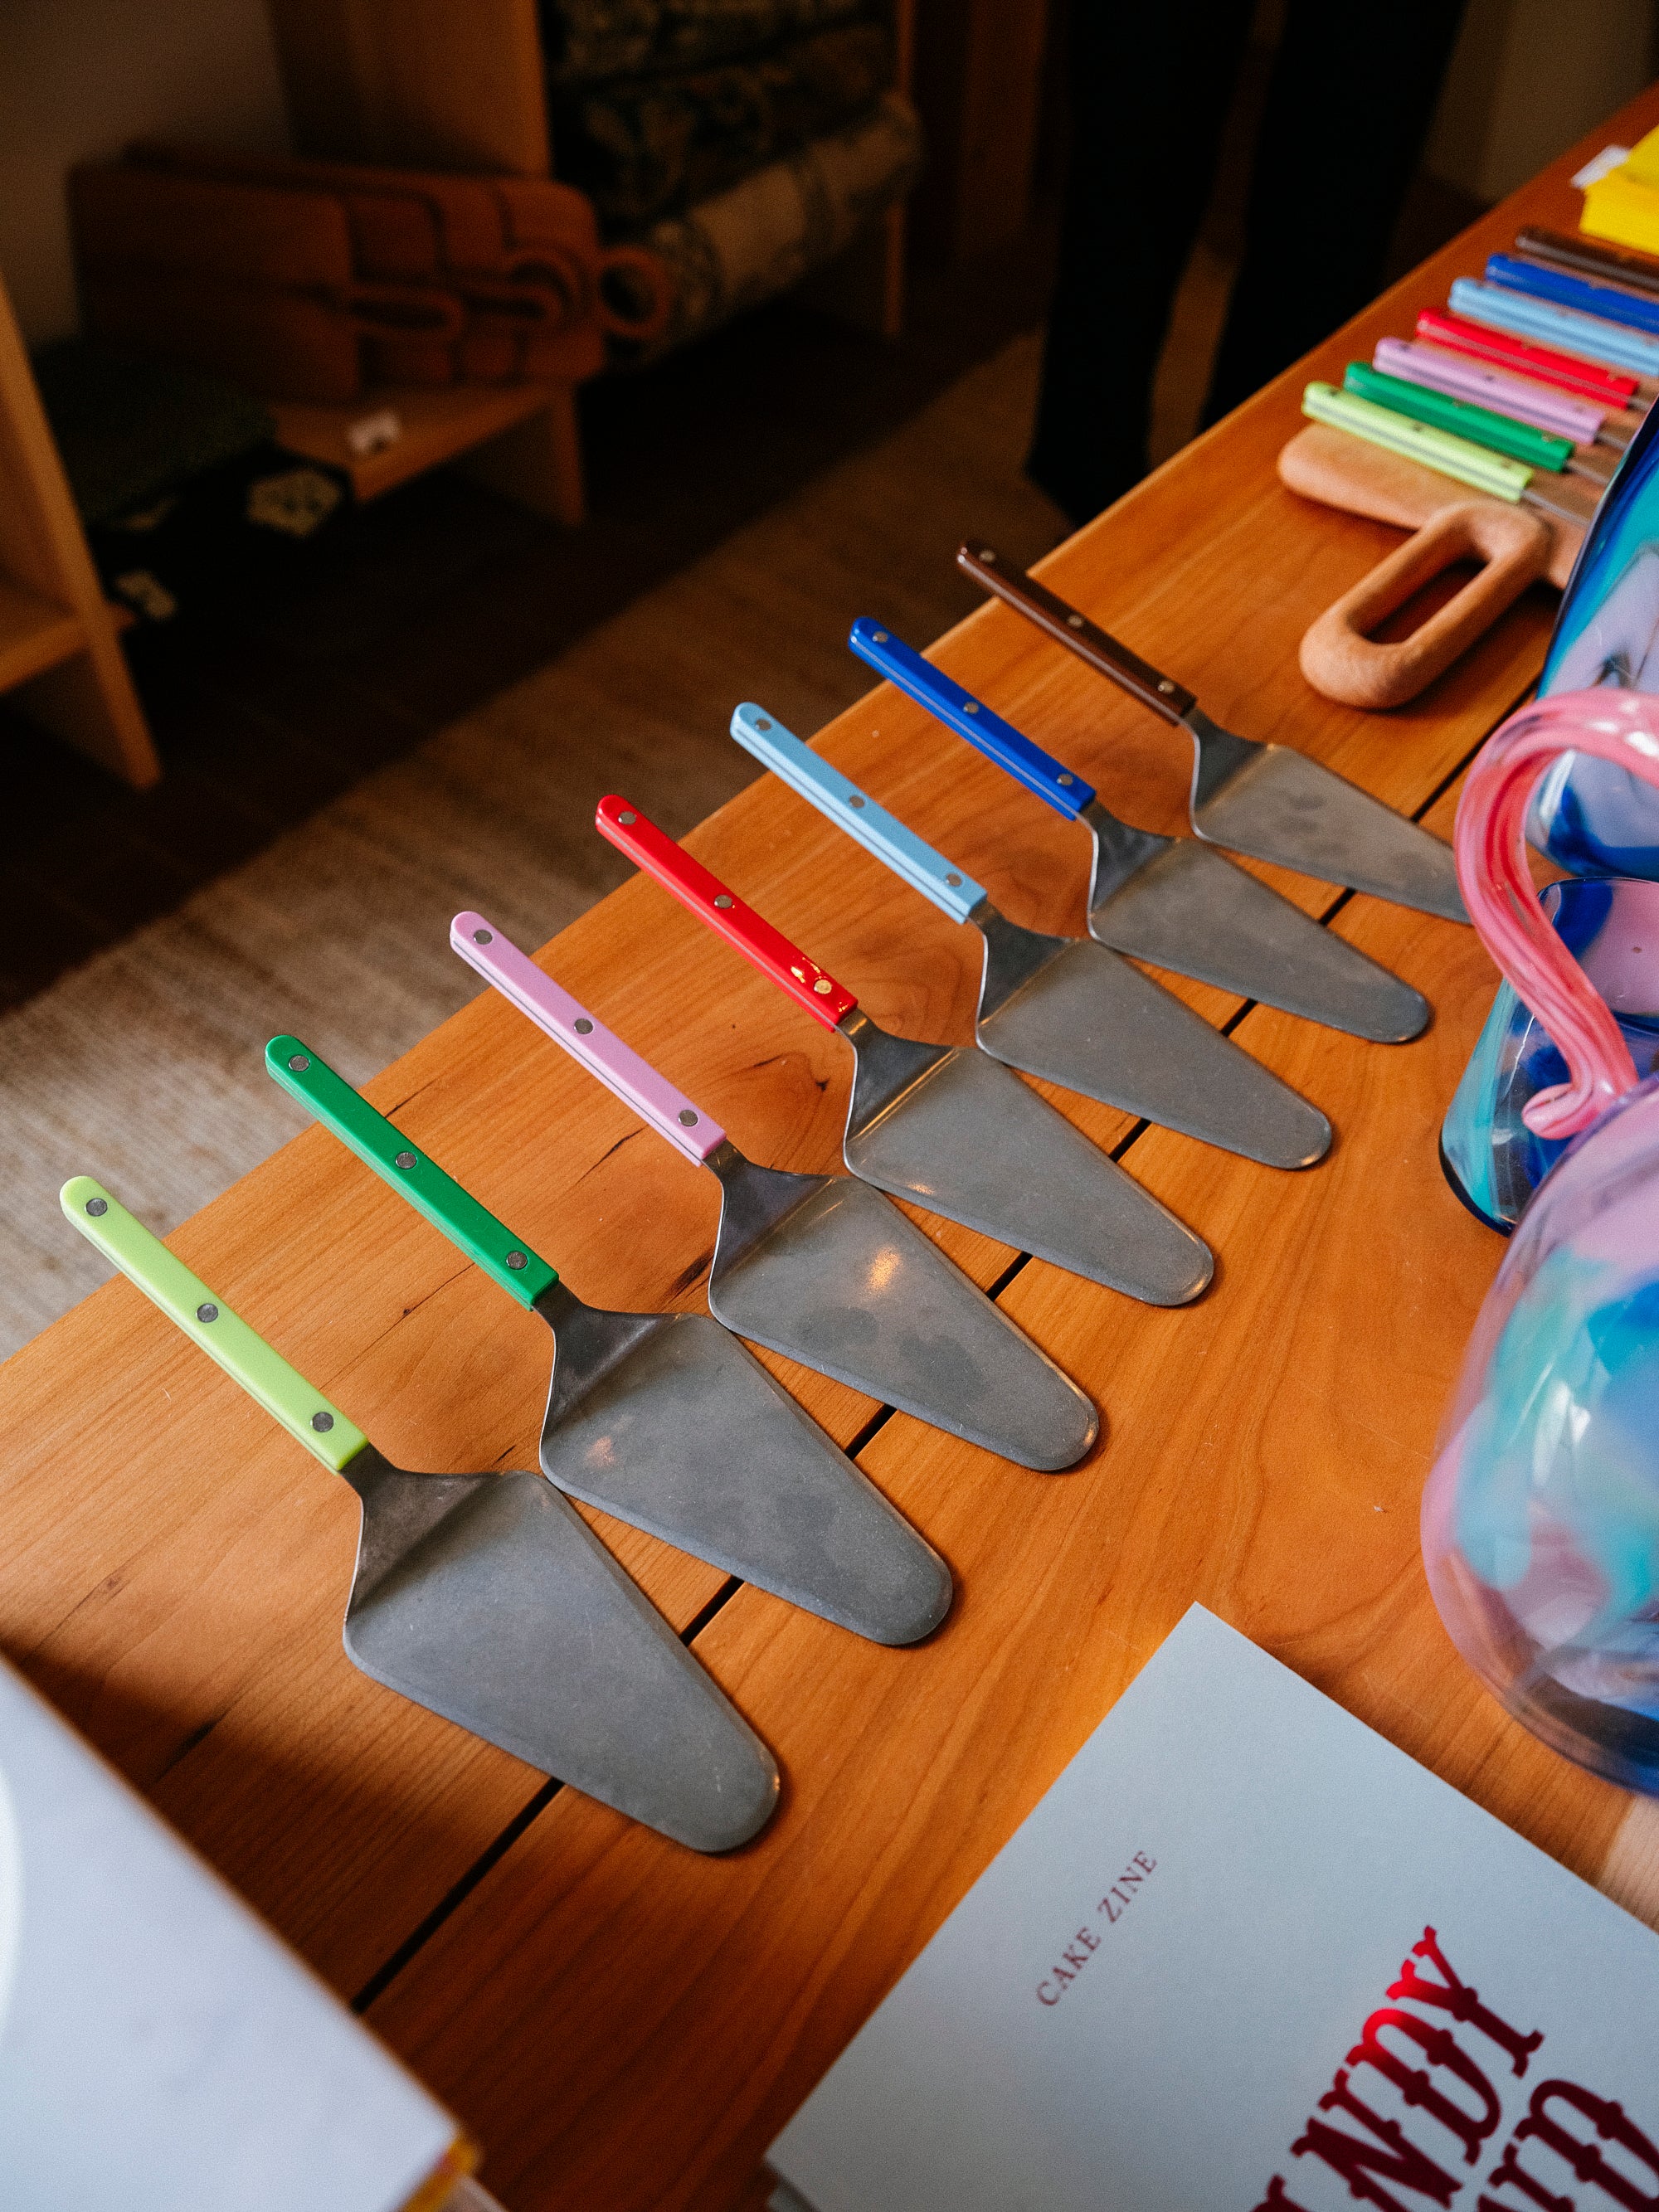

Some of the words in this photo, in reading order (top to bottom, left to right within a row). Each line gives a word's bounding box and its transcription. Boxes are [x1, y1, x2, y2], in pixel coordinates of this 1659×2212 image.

[1037, 1925, 1102, 2006] CAKE
[1097, 1850, 1158, 1923] ZINE
[1249, 1924, 1545, 2212] NDY
